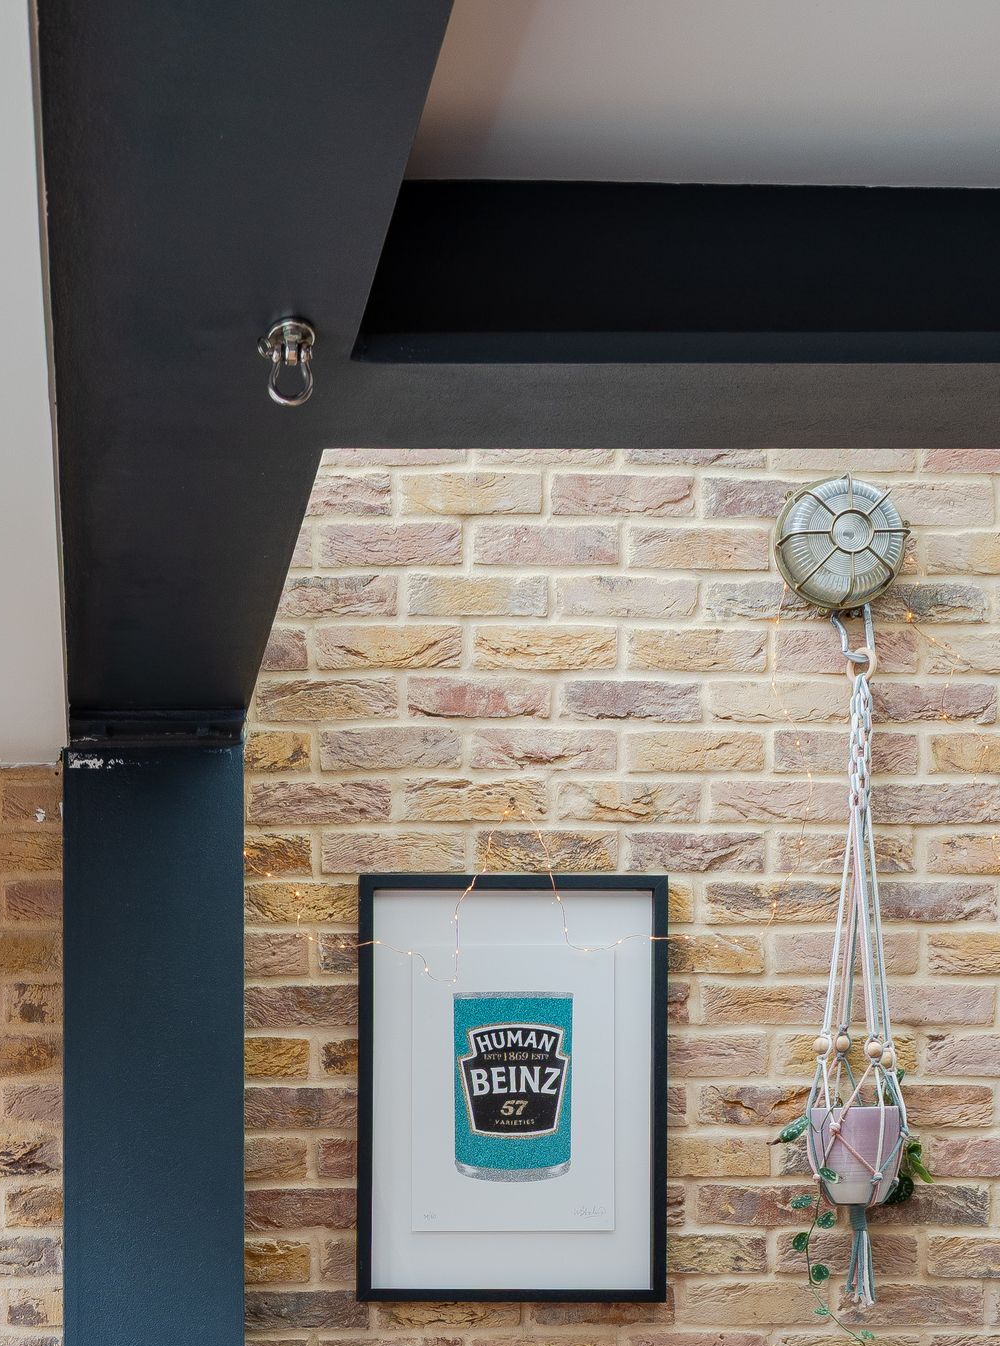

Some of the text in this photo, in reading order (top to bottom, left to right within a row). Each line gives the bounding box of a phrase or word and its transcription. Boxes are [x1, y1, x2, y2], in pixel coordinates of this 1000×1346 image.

[475, 1030, 556, 1053] HUMAN
[503, 1051, 529, 1061] 1869
[470, 1065, 561, 1096] BEINZ
[500, 1100, 529, 1116] 57
[495, 1118, 536, 1126] VARIETIES
